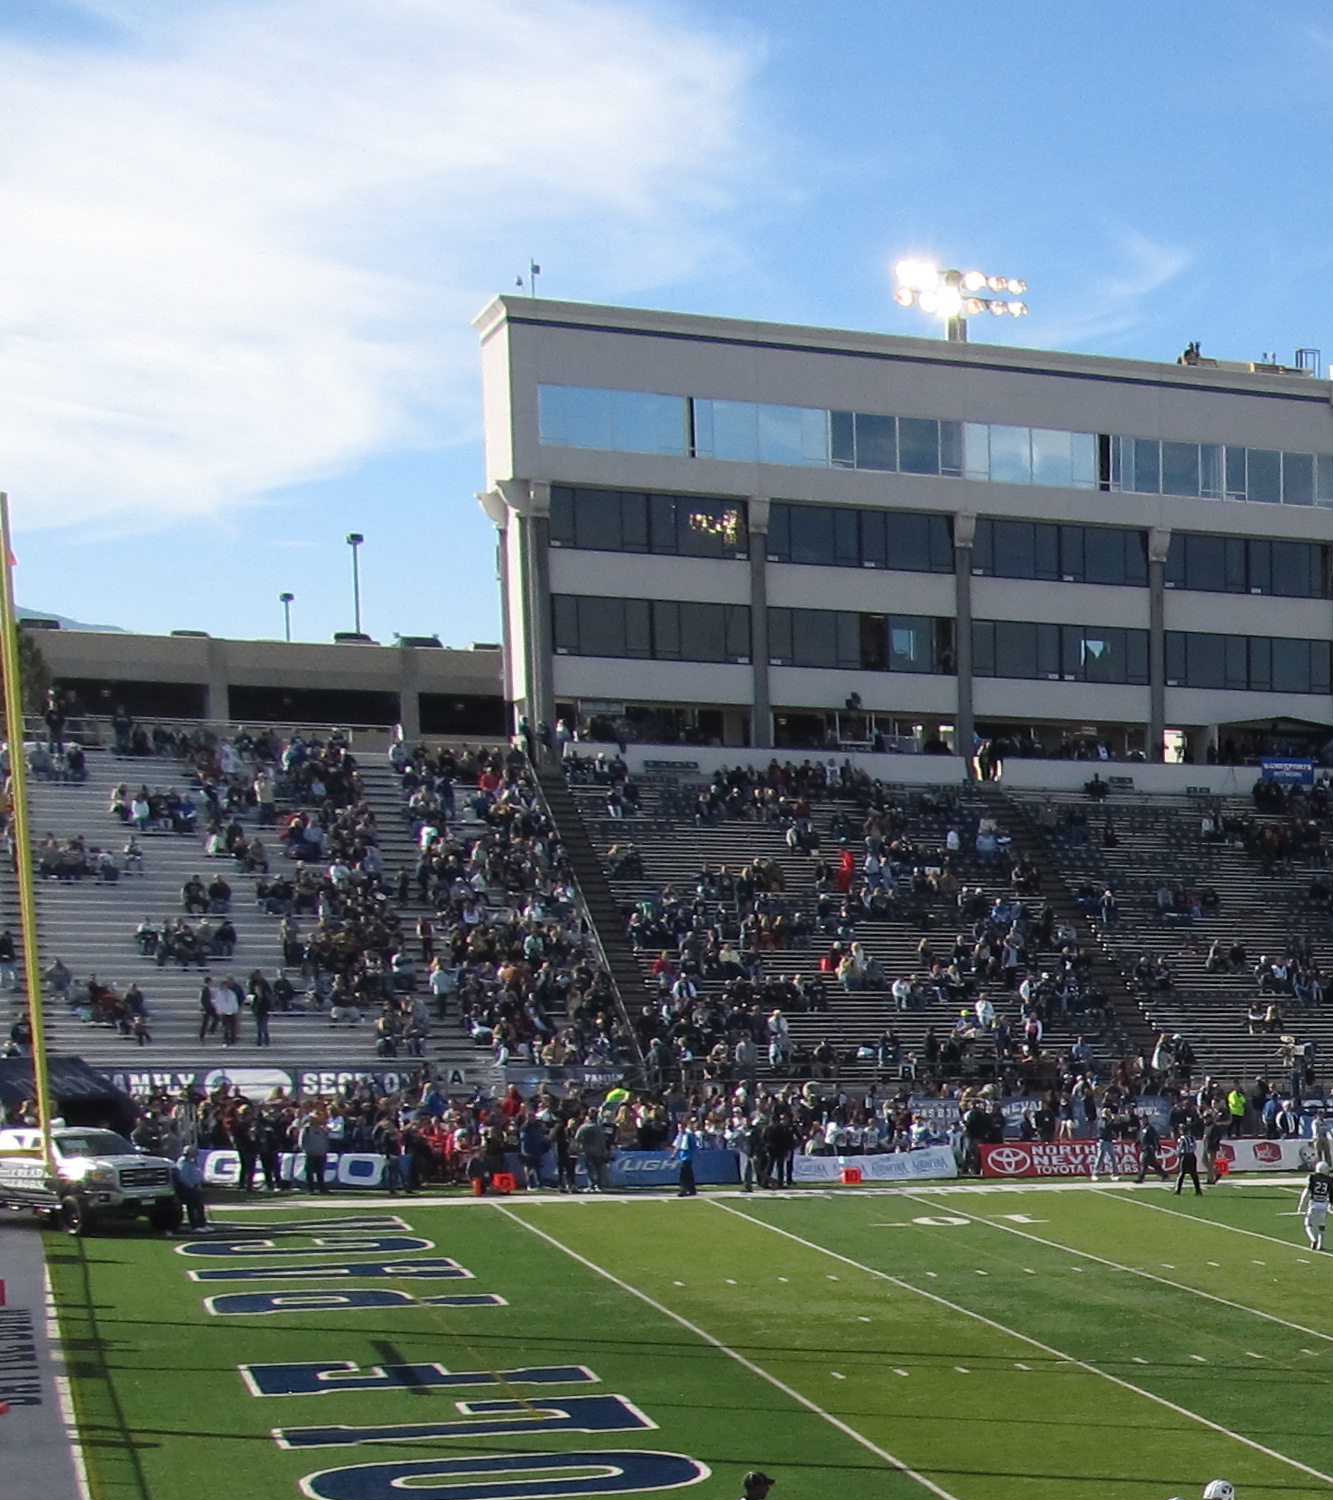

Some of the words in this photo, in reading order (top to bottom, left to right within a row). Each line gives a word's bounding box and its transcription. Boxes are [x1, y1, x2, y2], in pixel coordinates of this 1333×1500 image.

[110, 1073, 197, 1096] AMILY
[1035, 1164, 1086, 1175] TOYOTA
[1315, 1181, 1328, 1195] 23
